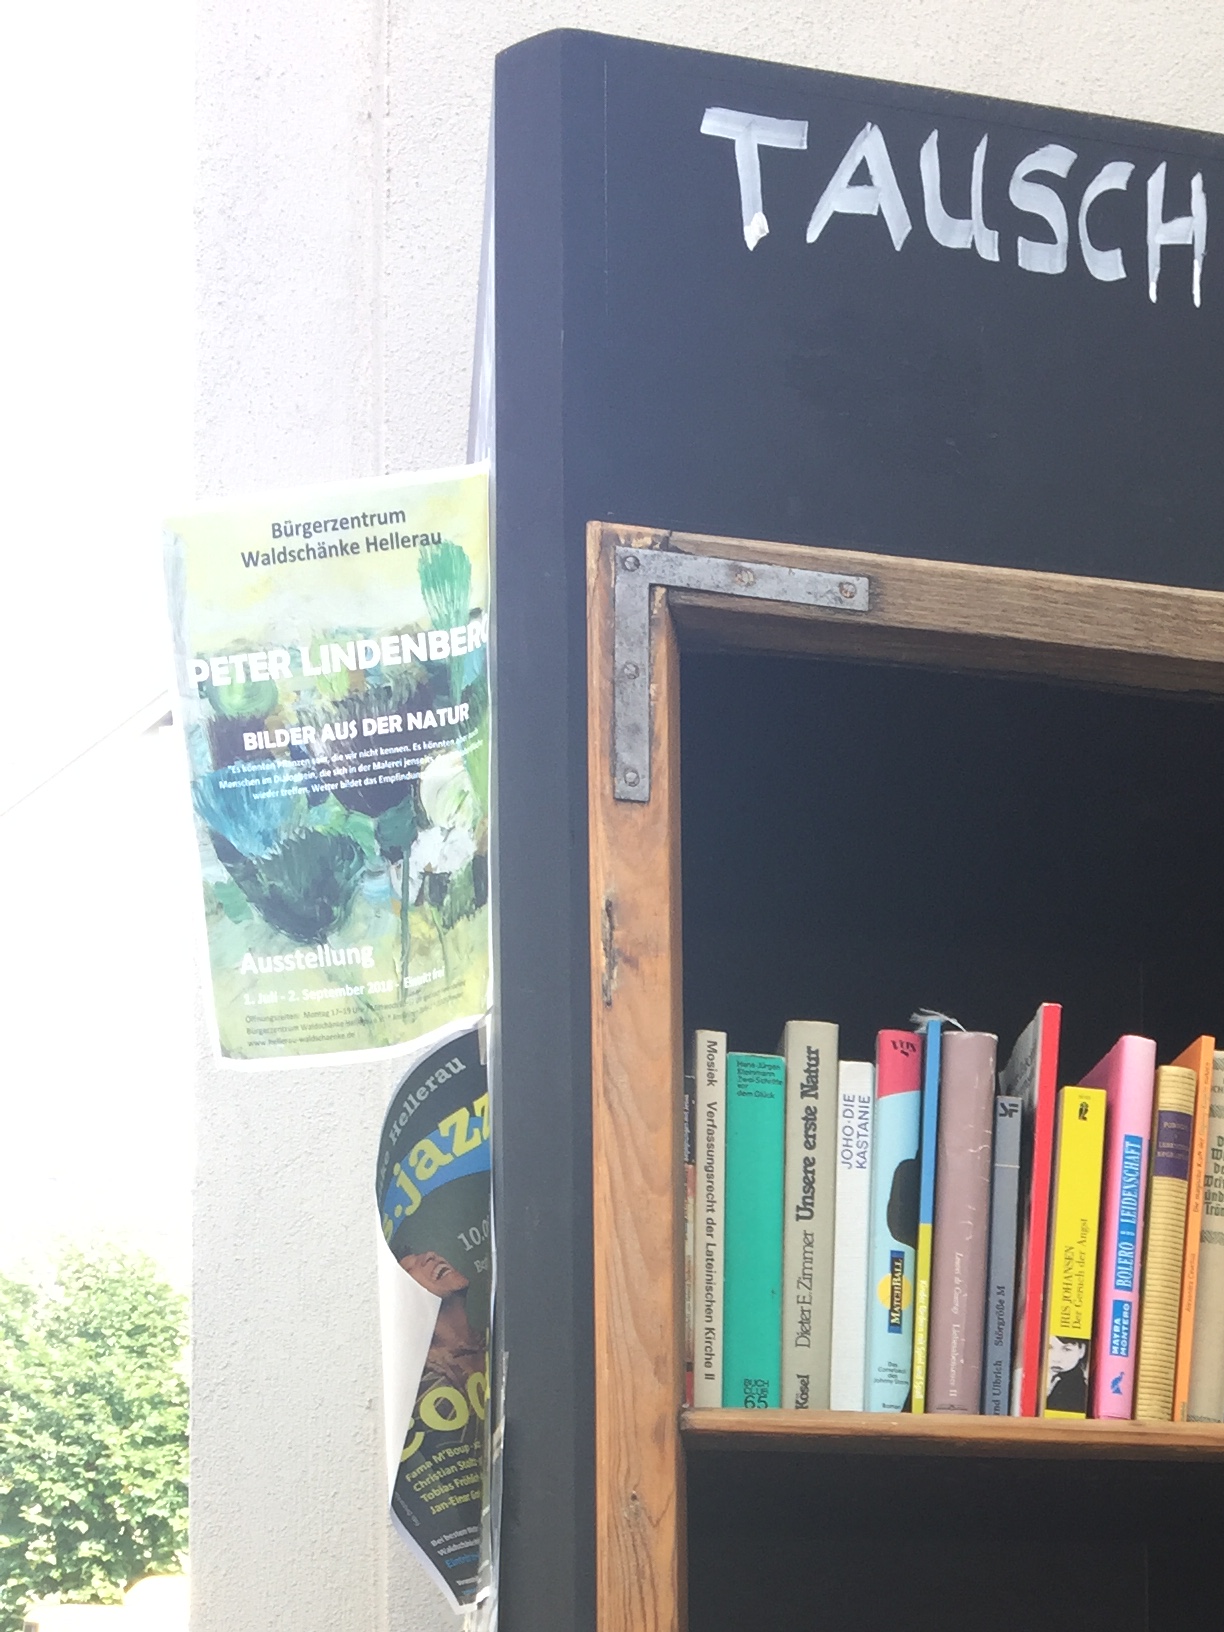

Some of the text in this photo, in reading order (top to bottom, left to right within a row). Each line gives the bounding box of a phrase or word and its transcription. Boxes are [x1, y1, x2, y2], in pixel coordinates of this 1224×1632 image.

[240, 528, 442, 571] Waldschänke Hellerau
[270, 508, 407, 541] Bürgerzentrum
[187, 648, 293, 691] PETER
[243, 703, 470, 752] BILDER AUS DER NATUR
[240, 943, 374, 975] Ausstellung
[388, 1056, 466, 1146] Hellerau
[855, 1095, 871, 1170] KASTANIE
[702, 1040, 719, 1381] Mosiek Verfassungsrecht der Lateinischen Kirche II
[794, 1045, 820, 1348] Dieter Unsere erste Natur
[1115, 1141, 1143, 1288] BOLERO LEIDENSCHAFT
[996, 1285, 1006, 1296] M
[1062, 1245, 1076, 1303] JOHANSEN
